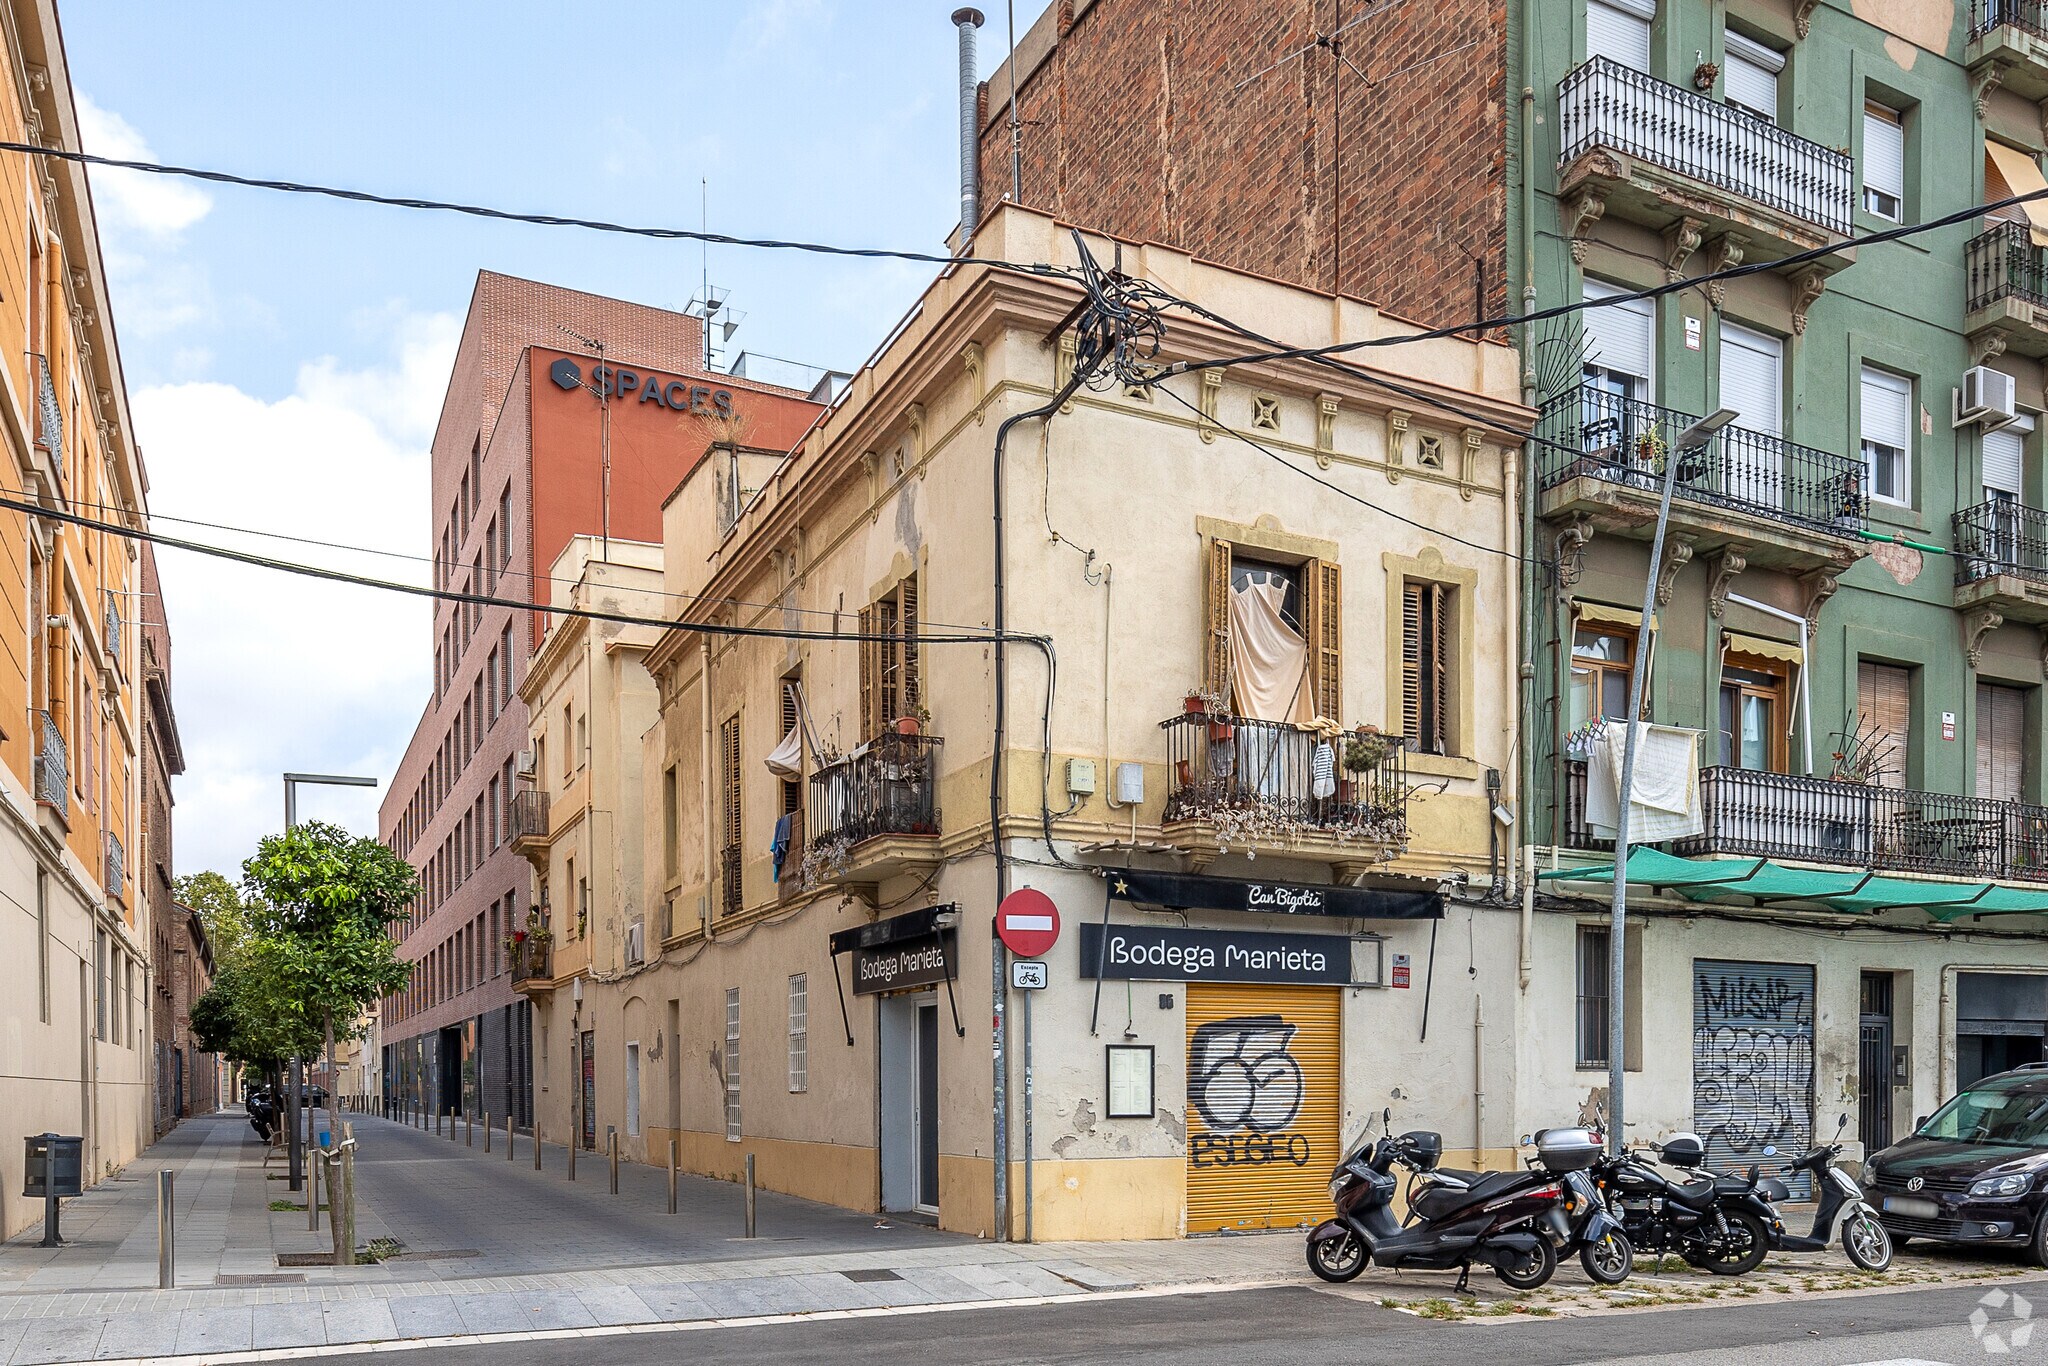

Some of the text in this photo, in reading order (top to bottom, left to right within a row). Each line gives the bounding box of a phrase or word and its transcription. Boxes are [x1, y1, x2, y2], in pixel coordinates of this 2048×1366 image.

[1249, 885, 1321, 913] Can Bigotis
[860, 947, 944, 982] Bodega Marieta
[1110, 937, 1326, 973] Bodega Marieta
